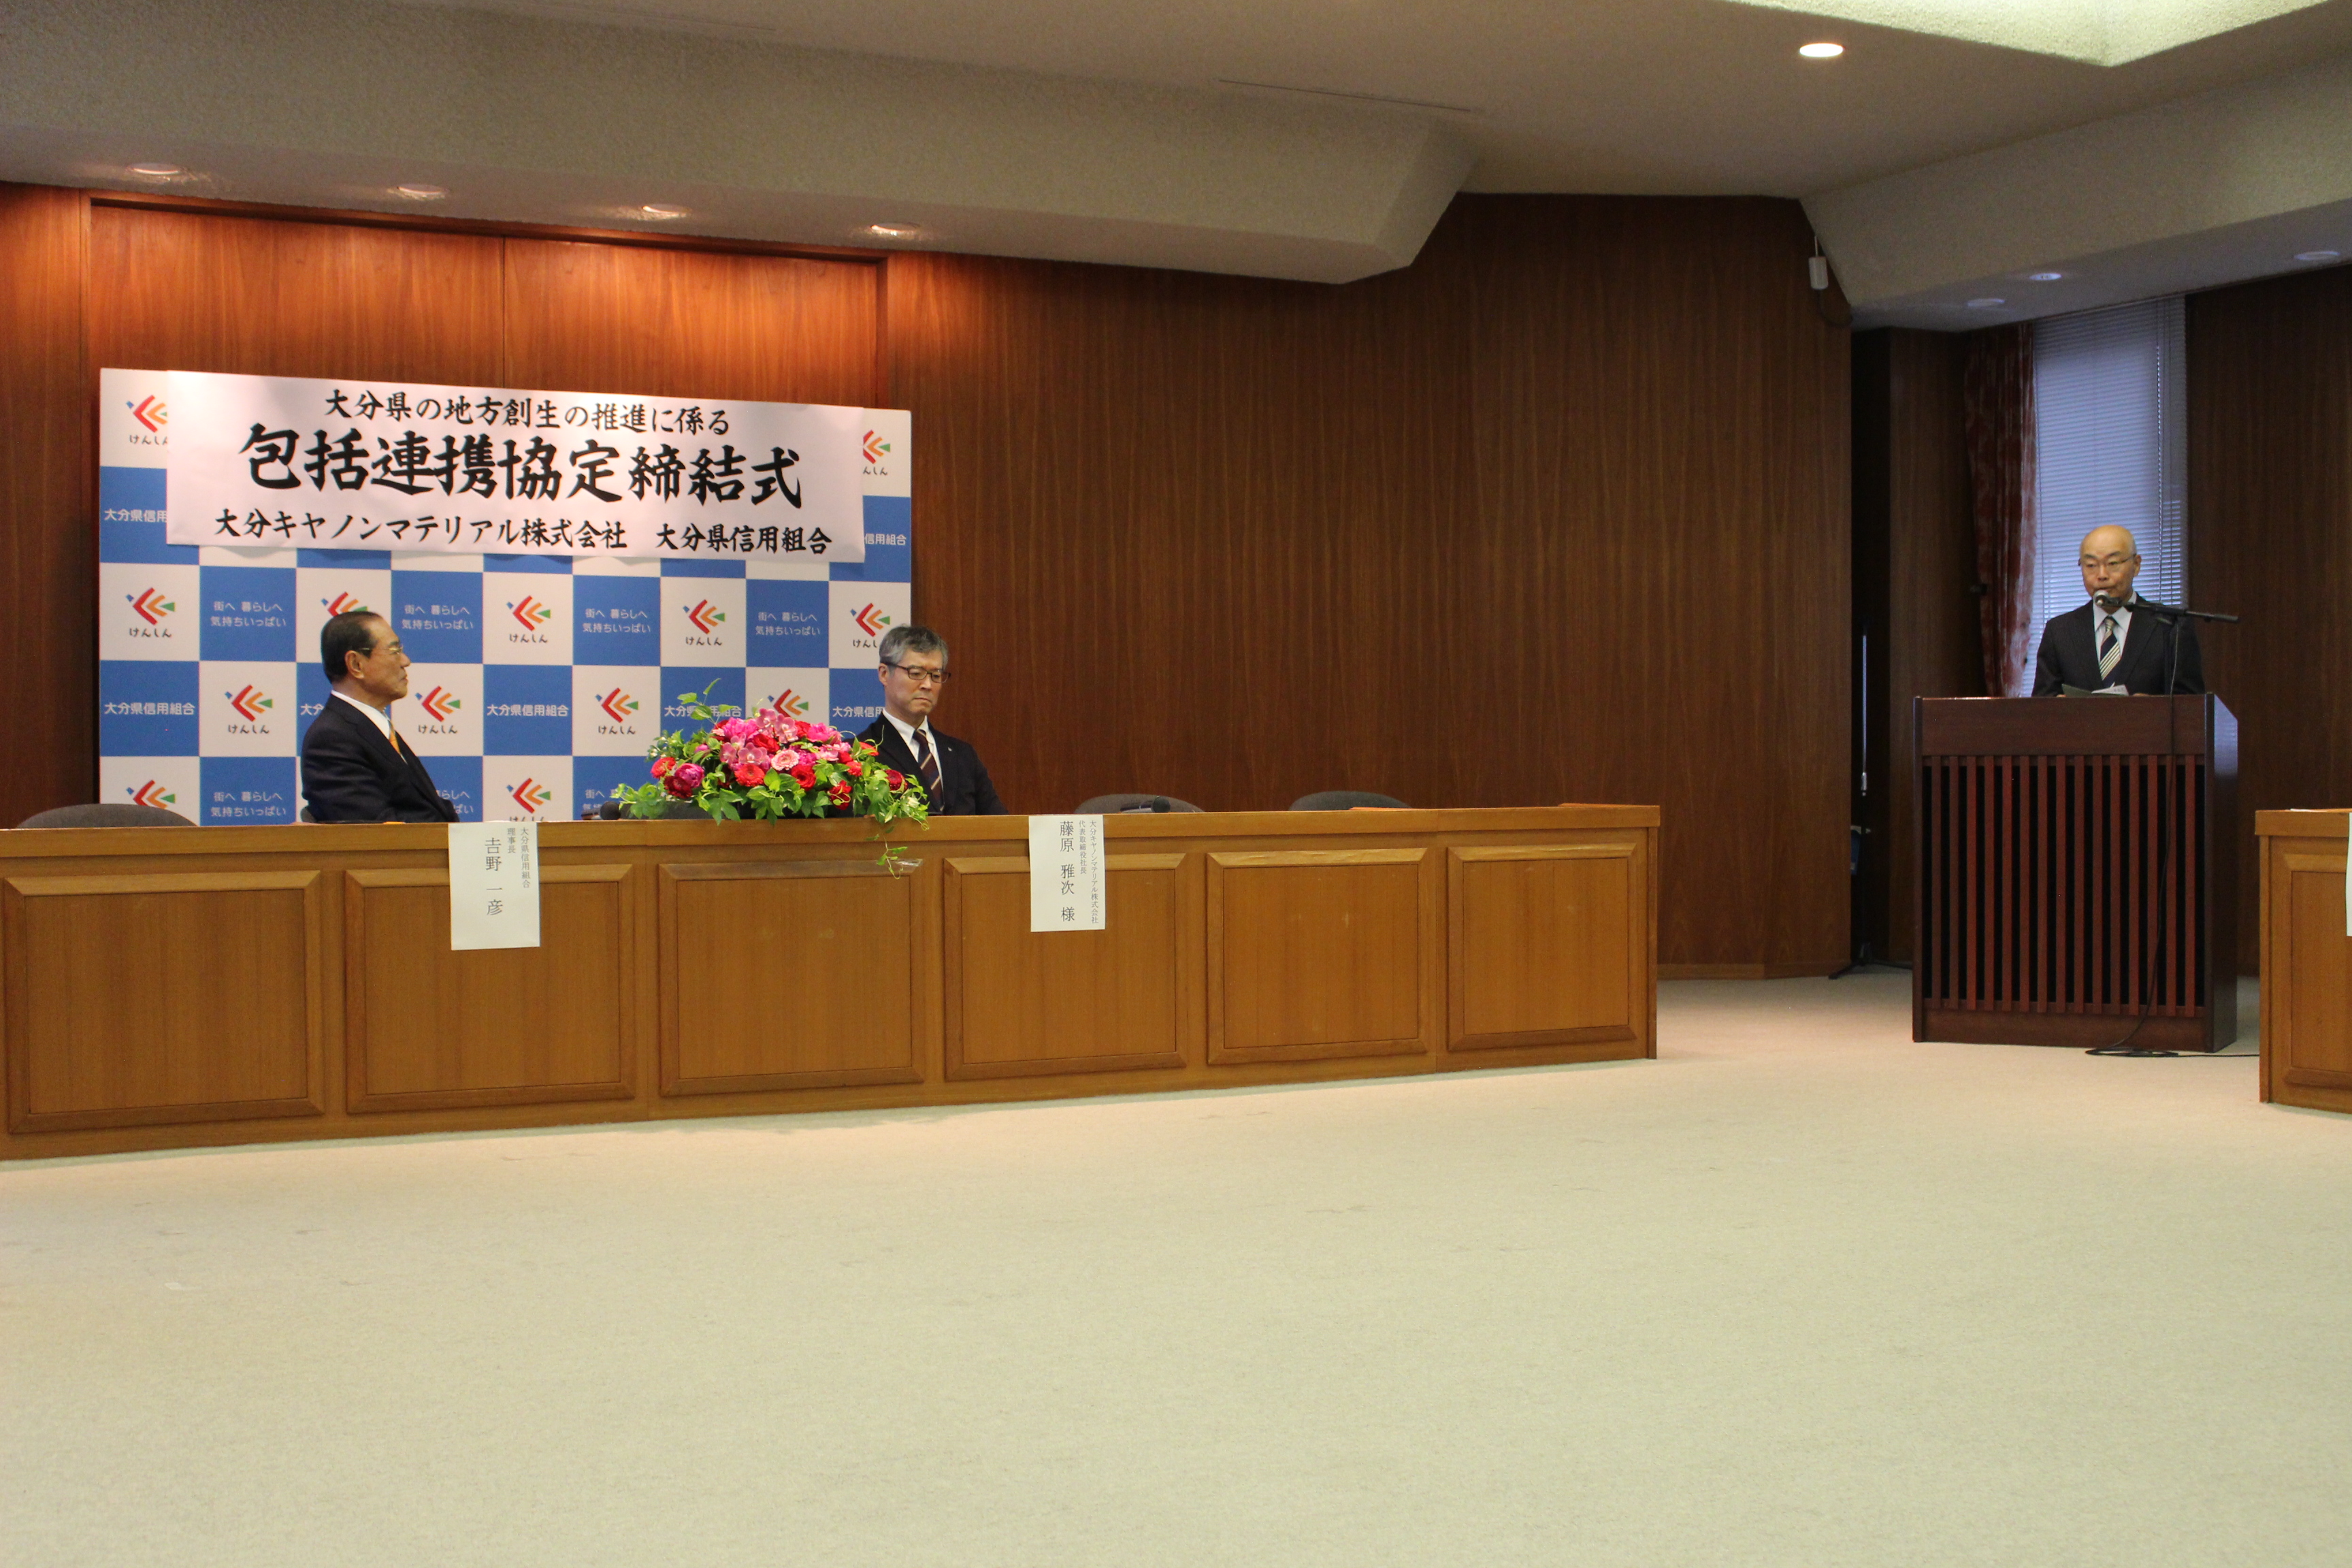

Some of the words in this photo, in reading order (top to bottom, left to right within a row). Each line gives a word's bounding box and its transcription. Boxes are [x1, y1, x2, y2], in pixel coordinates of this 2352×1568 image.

[325, 389, 729, 436] 大分県の地方創生の推進に係る
[239, 422, 802, 509] 包括連携協定締結式
[215, 508, 627, 549] 大分キヤノンマテリアル株式会社
[657, 523, 832, 555] 大分県信用組合
[214, 602, 235, 611] 街へ
[405, 605, 425, 615] 街へ
[585, 608, 604, 618] 街へ
[758, 612, 776, 621] 街へ
[211, 616, 286, 627] 気持ちいっぱい
[402, 619, 473, 630] 気持ちいっぱい
[129, 627, 172, 638] けんしん
[583, 623, 650, 633] 気持ちいっぱい
[755, 626, 820, 636] 気持ちいっぱい
[510, 634, 547, 643] けんしん
[686, 636, 722, 646] けんしん
[105, 702, 195, 715] 大分県信用組合
[487, 704, 569, 717] 大分県信用組合
[228, 725, 269, 734] けんしん
[419, 725, 457, 734] けんしん
[598, 725, 636, 734] けんしん
[214, 792, 235, 802] 街へ
[211, 806, 286, 817] 気持ちいっぱい
[507, 828, 516, 854] 理事長
[1060, 821, 1075, 853] 藤原
[1079, 820, 1088, 875] 代表取締役社長
[521, 827, 530, 888] 大分県信用組合
[1060, 864, 1075, 896] 雅次
[486, 887, 504, 916] 一彦
[1060, 906, 1075, 921] 様
